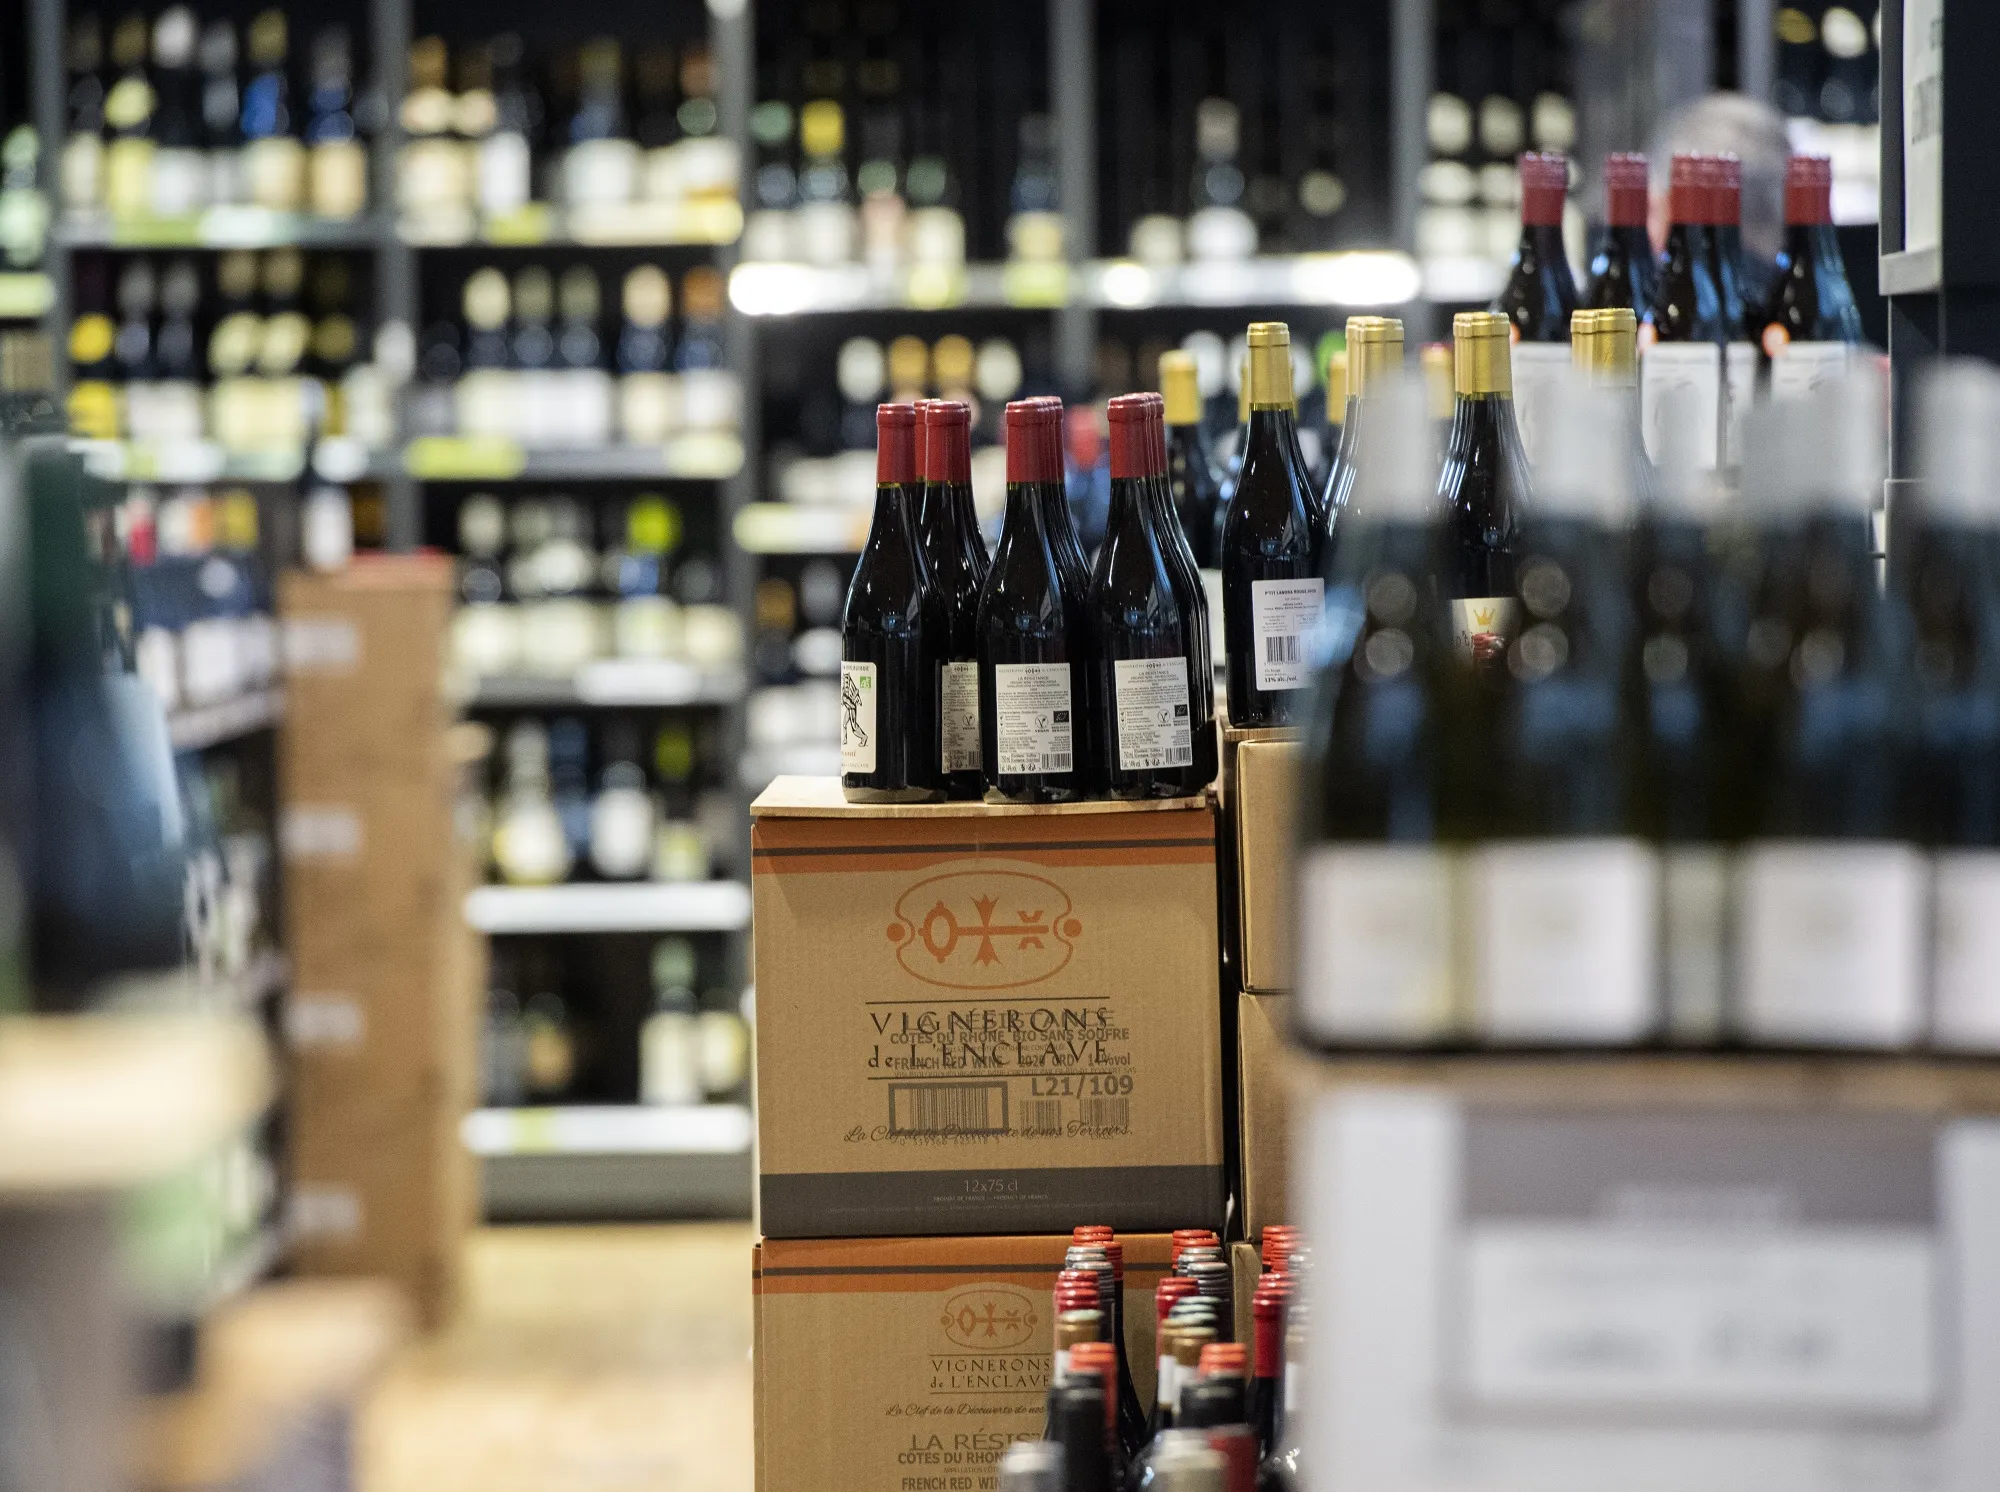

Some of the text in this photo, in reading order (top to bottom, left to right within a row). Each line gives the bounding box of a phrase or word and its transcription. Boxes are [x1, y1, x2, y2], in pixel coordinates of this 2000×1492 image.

[870, 1007, 1108, 1036] VIGNERONS
[1012, 1029, 1037, 1043] BIO
[1040, 1028, 1074, 1042] SANS
[868, 1040, 1108, 1069] de L'ENCLAVE
[894, 1055, 939, 1070] FRENCH
[1031, 1074, 1134, 1099] L21/109
[843, 1125, 868, 1143] La
[964, 1178, 1019, 1193] 12x75 cl
[931, 1358, 1050, 1373] VIGNERONS
[930, 1374, 1049, 1389] de L'ENCLAVE
[885, 1403, 904, 1416] La
[905, 1403, 930, 1416] Clef
[929, 1405, 942, 1415] de
[943, 1404, 954, 1415] la
[1014, 1404, 1027, 1415] de
[909, 1434, 944, 1451] LA
[944, 1451, 962, 1465] DU
[902, 1476, 947, 1491] FRENCH
[951, 1476, 972, 1490] RED
